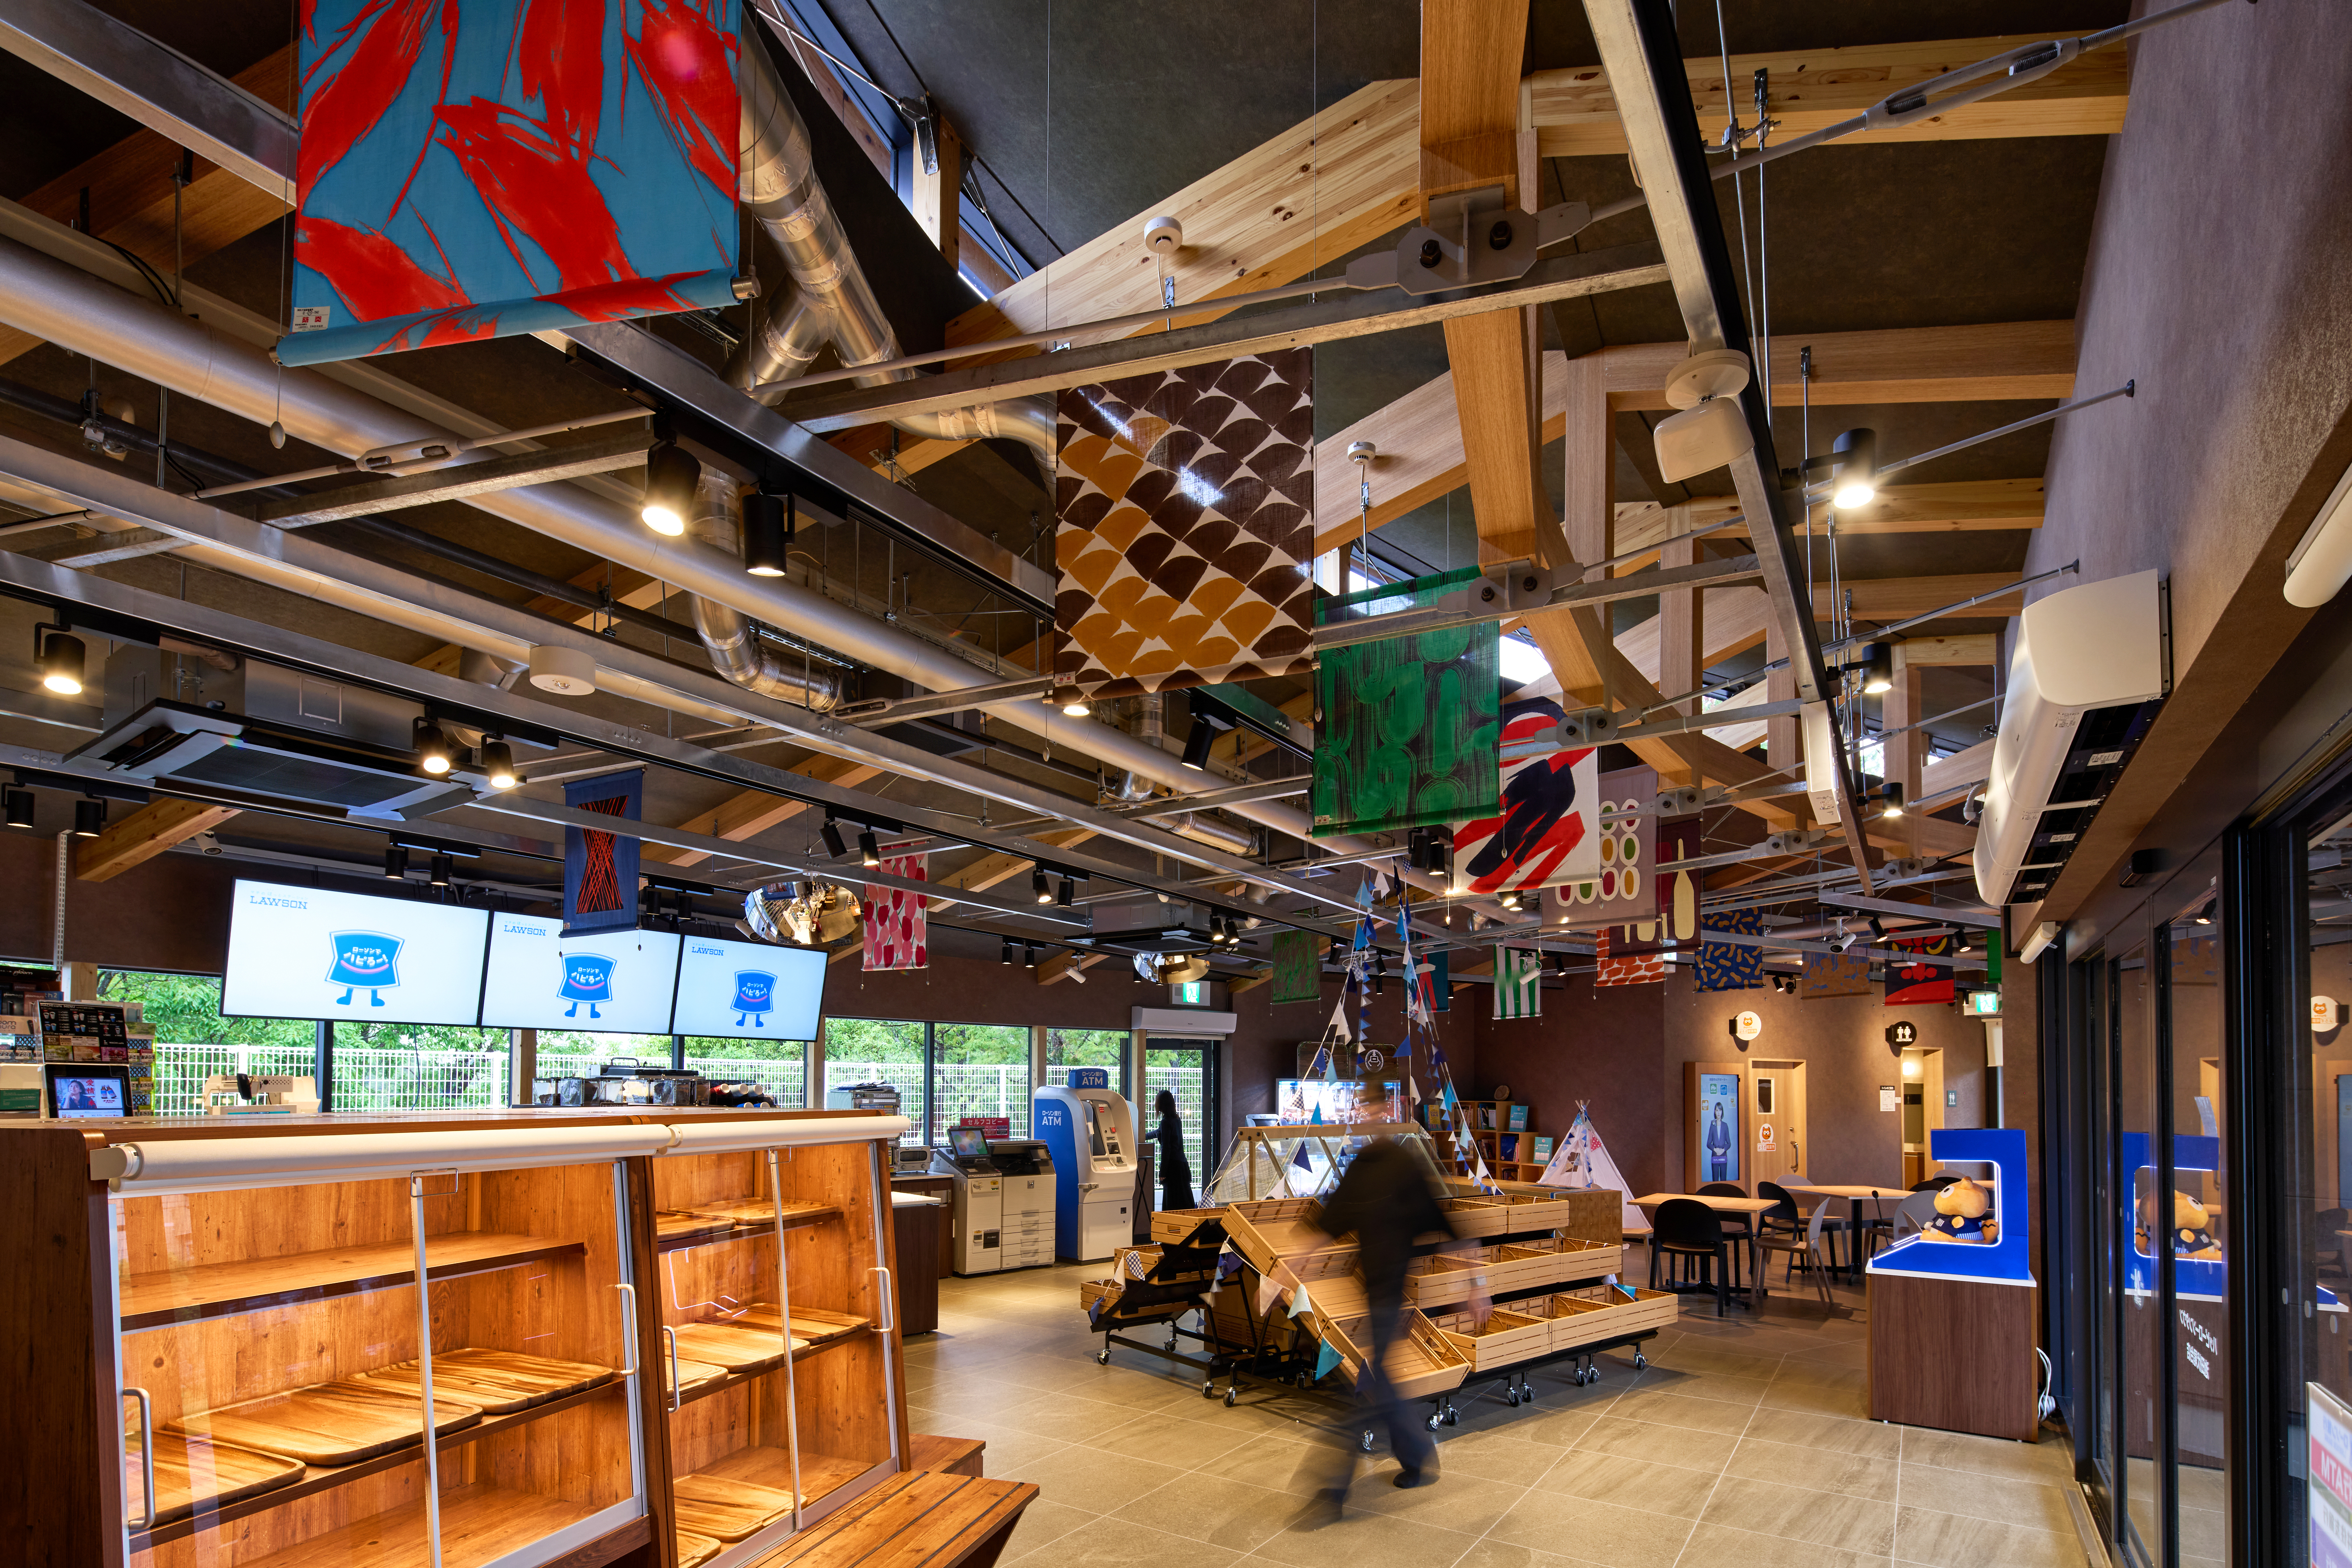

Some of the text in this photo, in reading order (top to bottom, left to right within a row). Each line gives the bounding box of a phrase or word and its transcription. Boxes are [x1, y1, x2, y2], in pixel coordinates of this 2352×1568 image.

[250, 896, 308, 909] LAWSON
[504, 925, 546, 936] LAWSON
[352, 947, 381, 955] ローソンで
[691, 947, 724, 956] LAWSON
[1082, 1077, 1103, 1085] ATM
[1042, 1116, 1061, 1126] ATM
